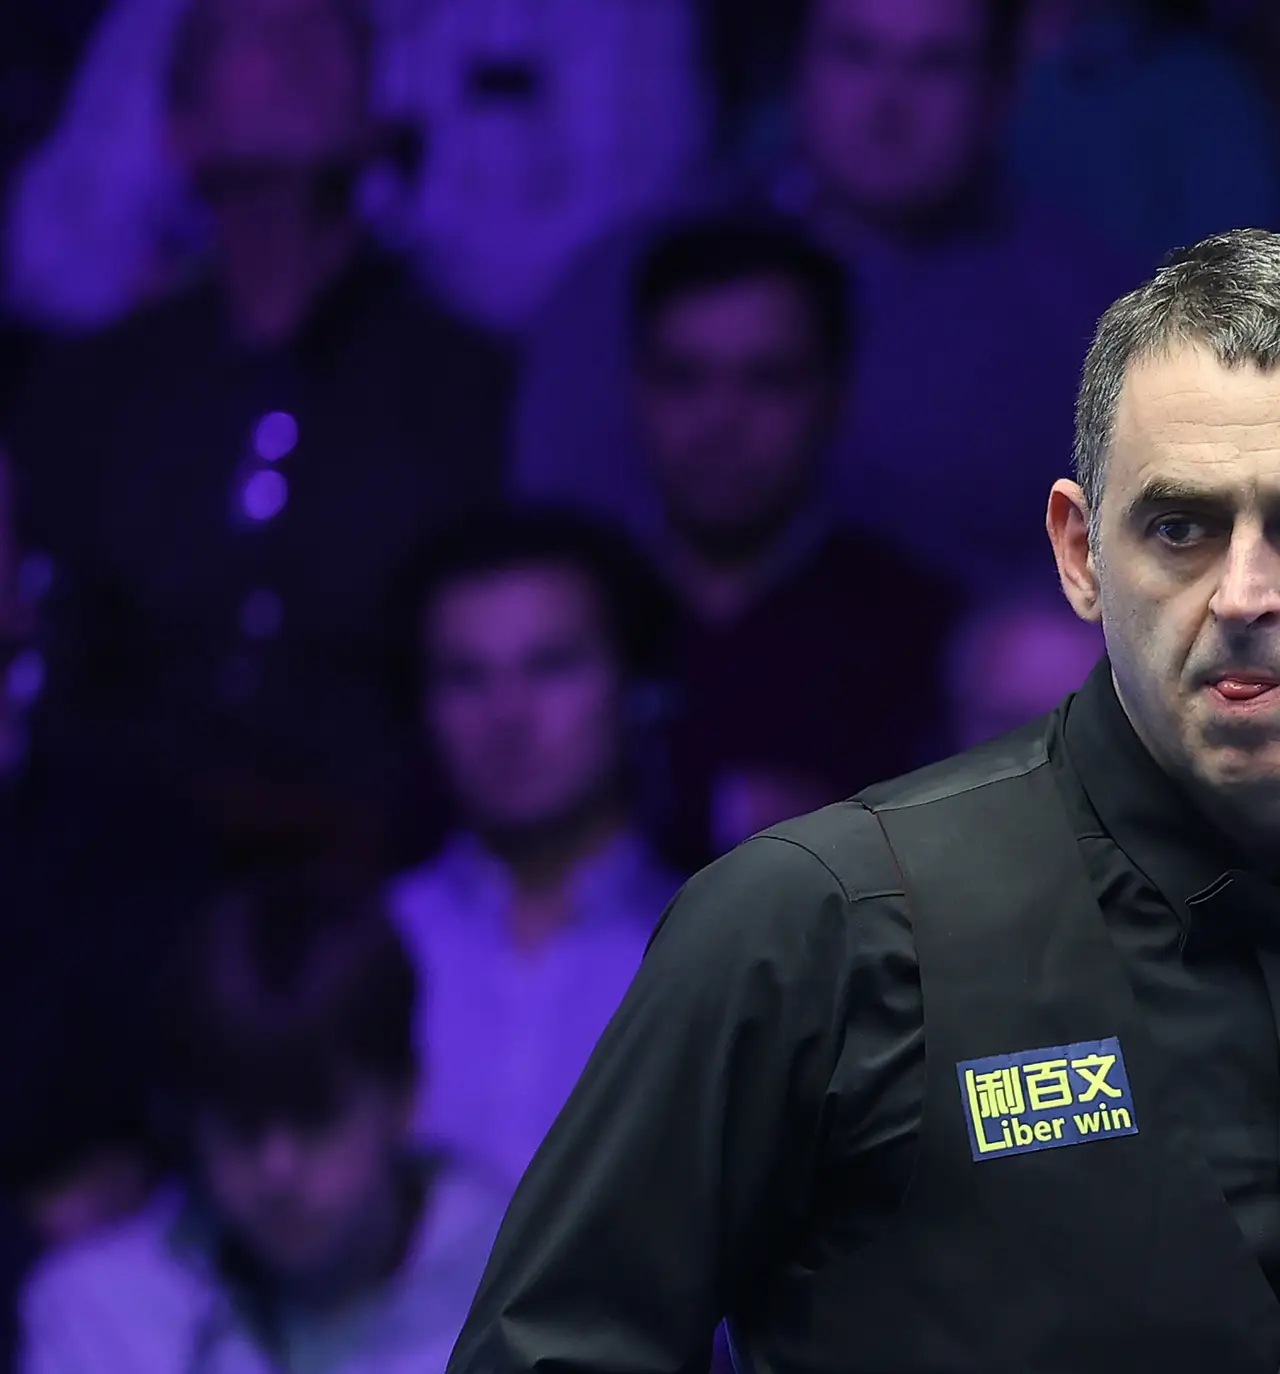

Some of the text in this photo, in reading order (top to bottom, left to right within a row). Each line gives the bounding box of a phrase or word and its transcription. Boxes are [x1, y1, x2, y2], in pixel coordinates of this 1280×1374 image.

[965, 1069, 1132, 1153] Liber win
[975, 1054, 1123, 1119] 利百文
